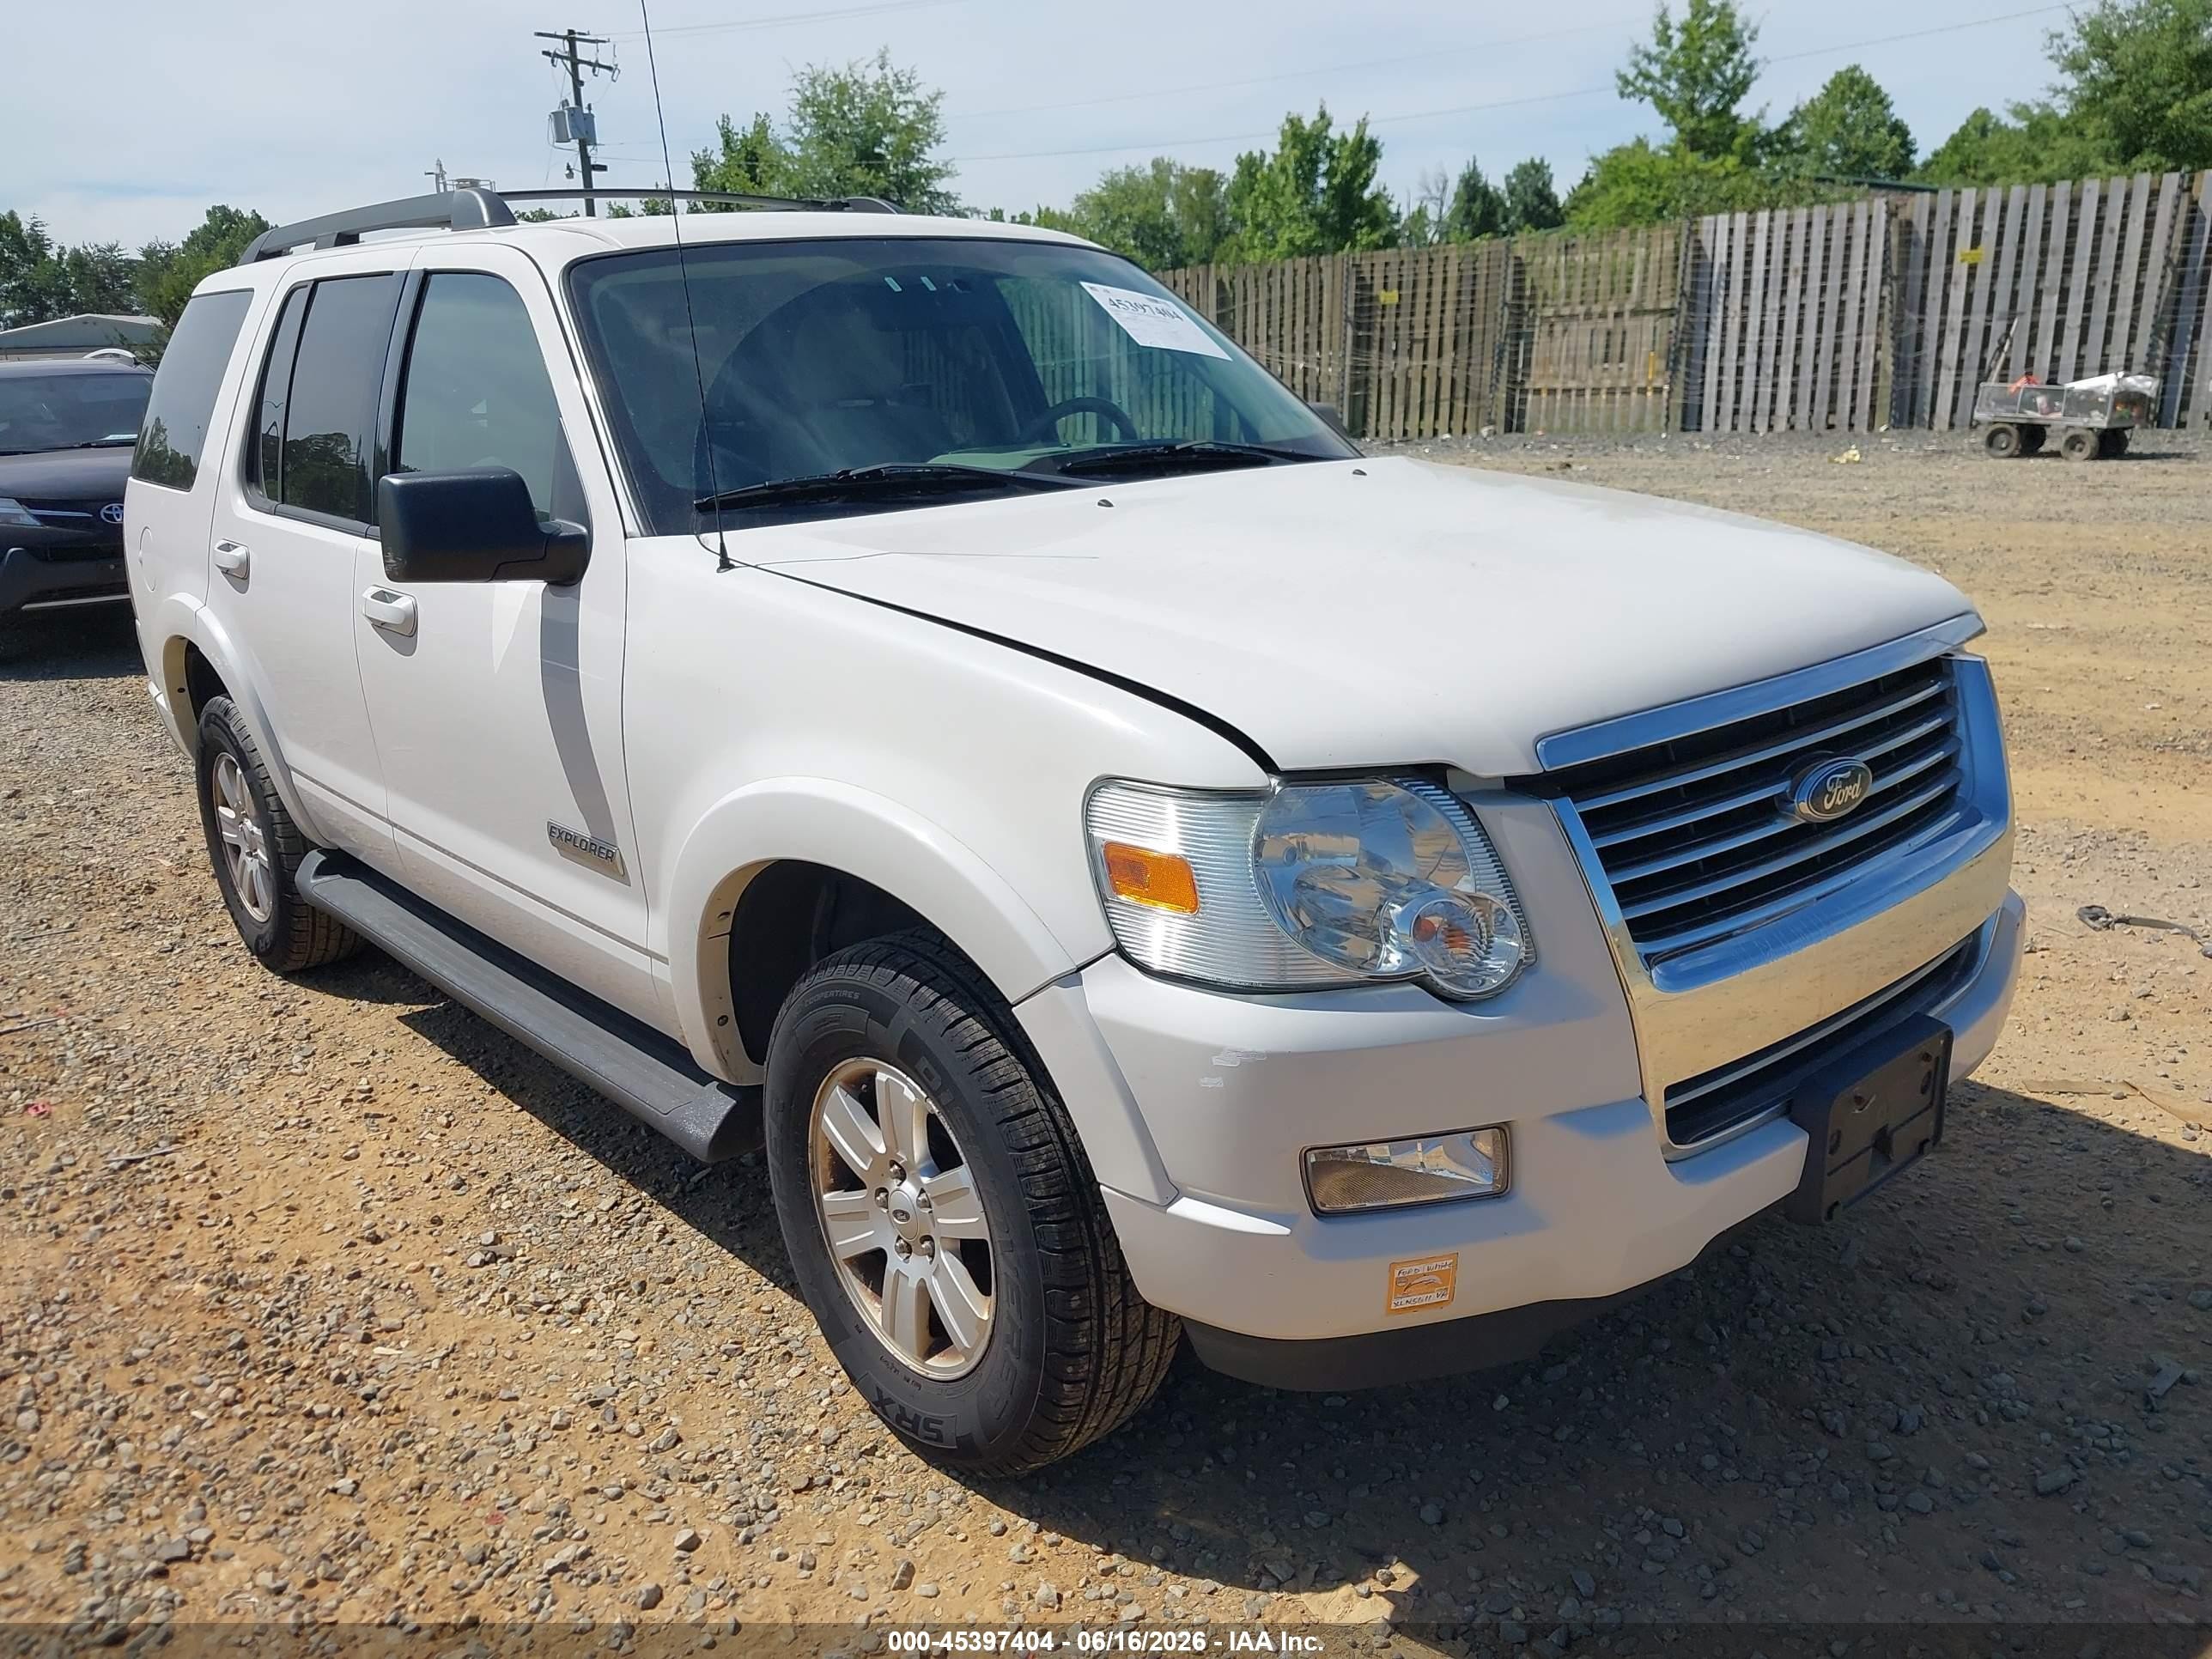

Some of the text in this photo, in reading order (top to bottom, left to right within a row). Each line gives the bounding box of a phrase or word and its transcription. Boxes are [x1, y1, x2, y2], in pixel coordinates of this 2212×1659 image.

[1823, 770, 1863, 811] Ford
[548, 825, 615, 863] EXPLORER
[872, 1383, 944, 1443] SRX
